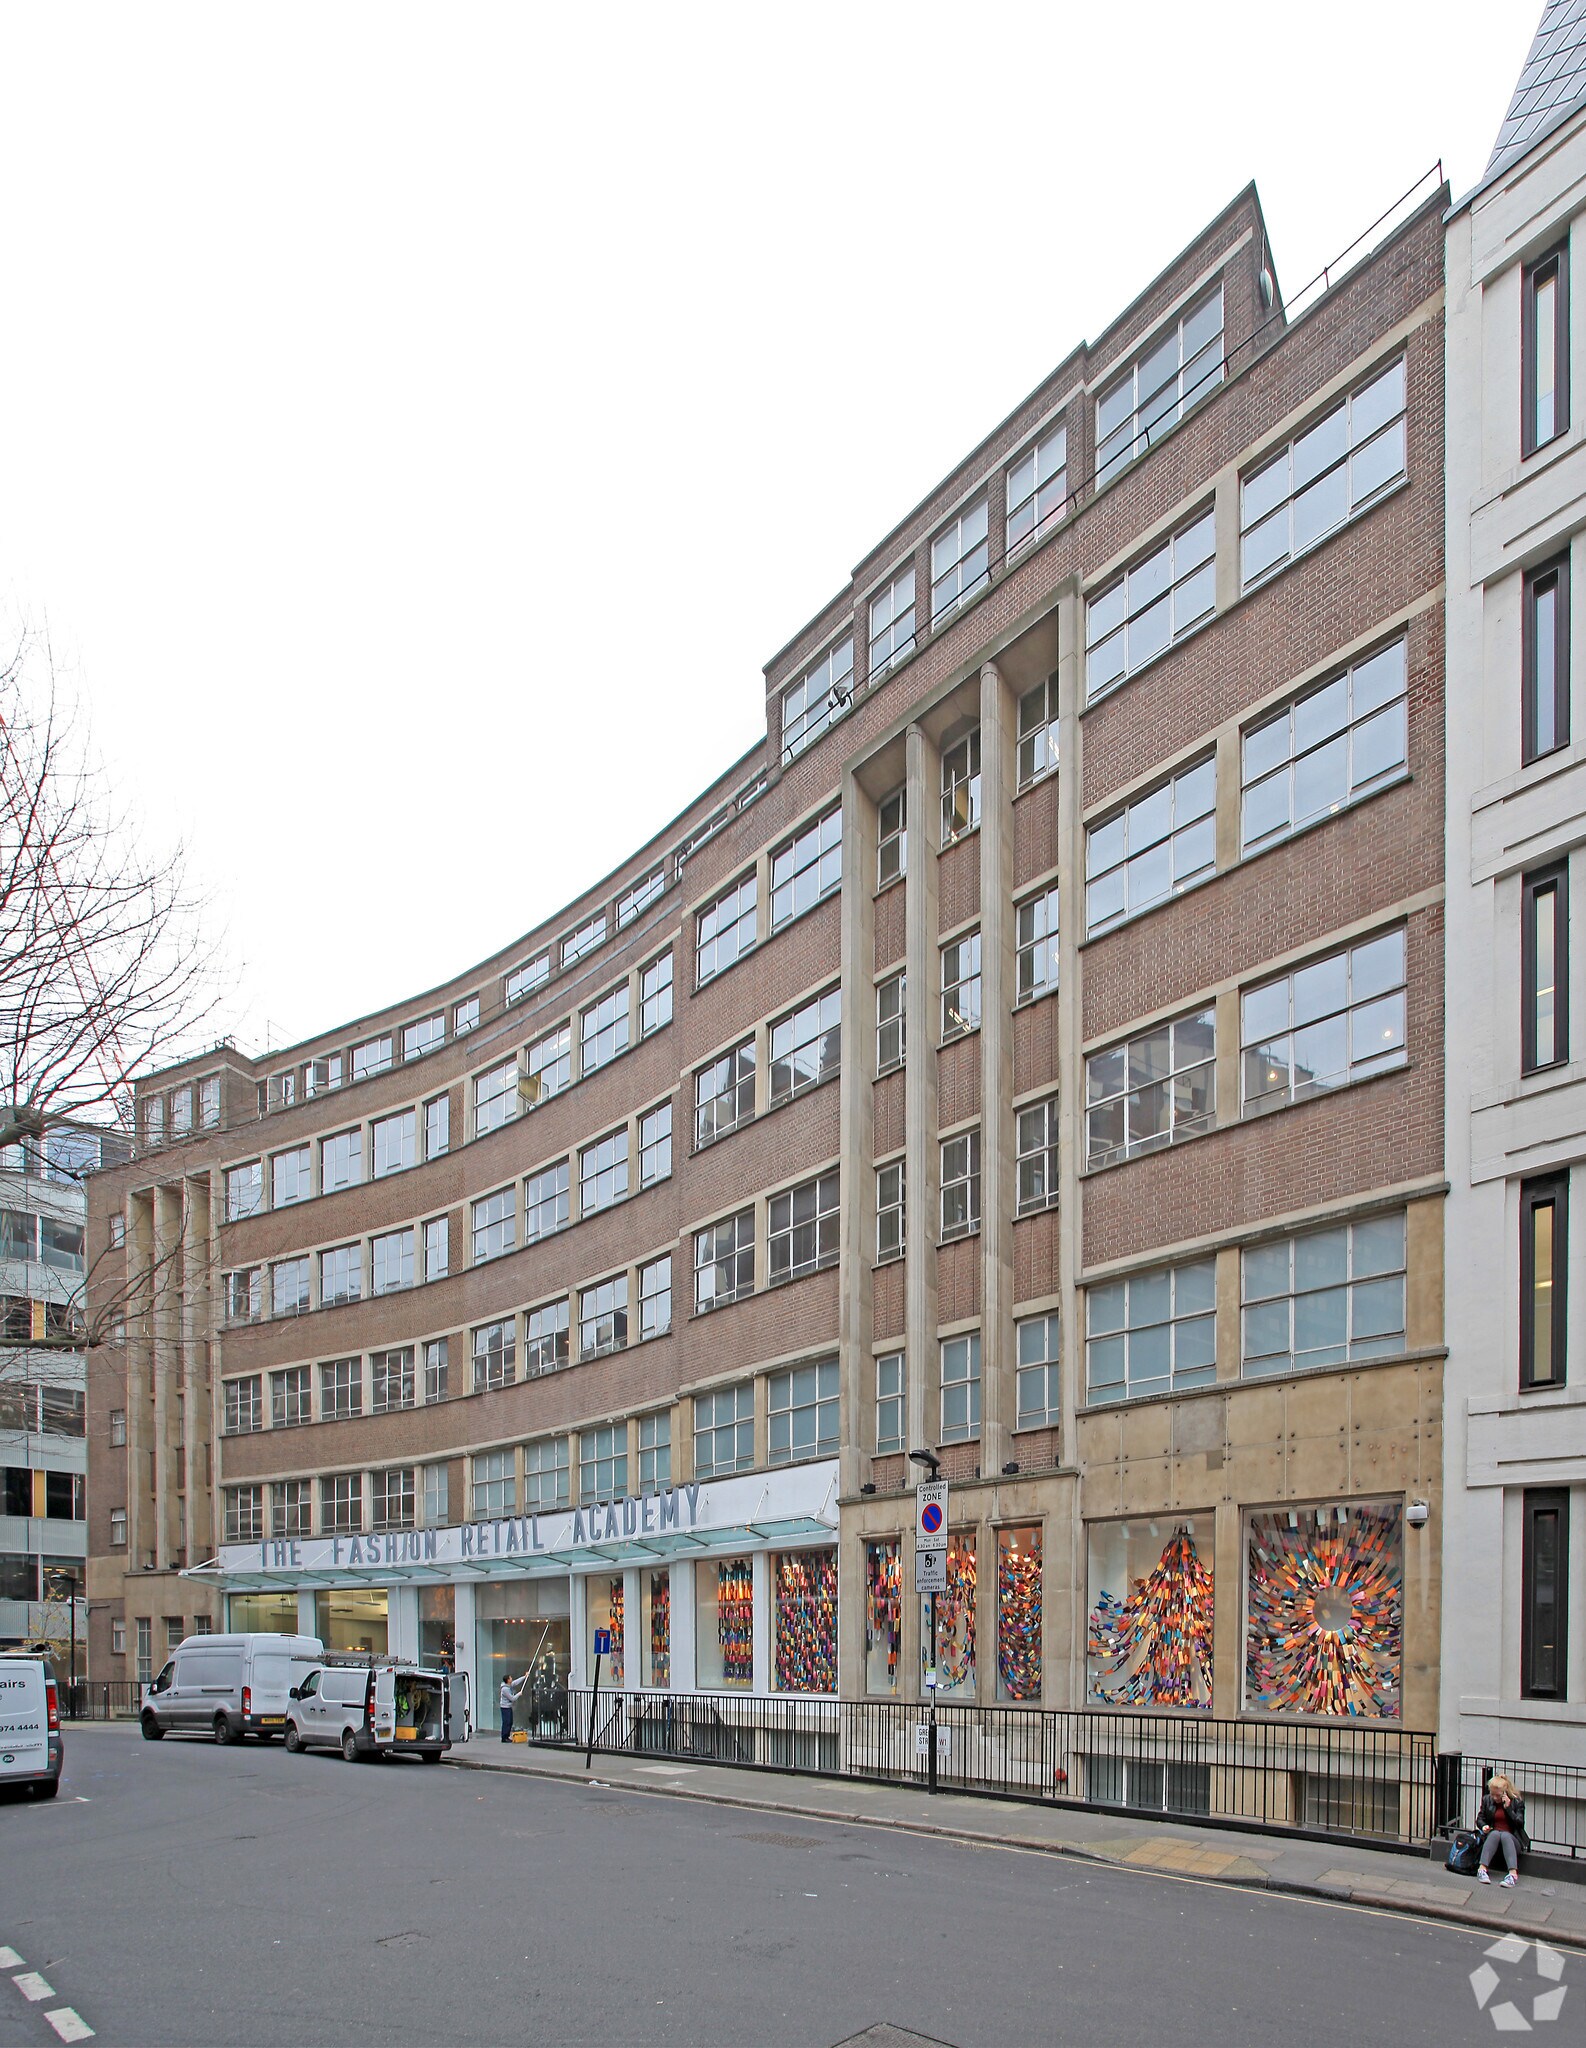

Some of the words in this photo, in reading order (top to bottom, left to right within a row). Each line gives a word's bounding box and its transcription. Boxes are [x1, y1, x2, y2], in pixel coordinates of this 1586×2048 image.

[919, 1483, 946, 1492] Controlled
[923, 1492, 941, 1501] ZONE
[259, 1537, 302, 1567] THE
[333, 1528, 437, 1564] FASHION
[460, 1514, 544, 1556] RETAIL
[573, 1483, 700, 1544] ACADEMY
[938, 1738, 947, 1746] W1
